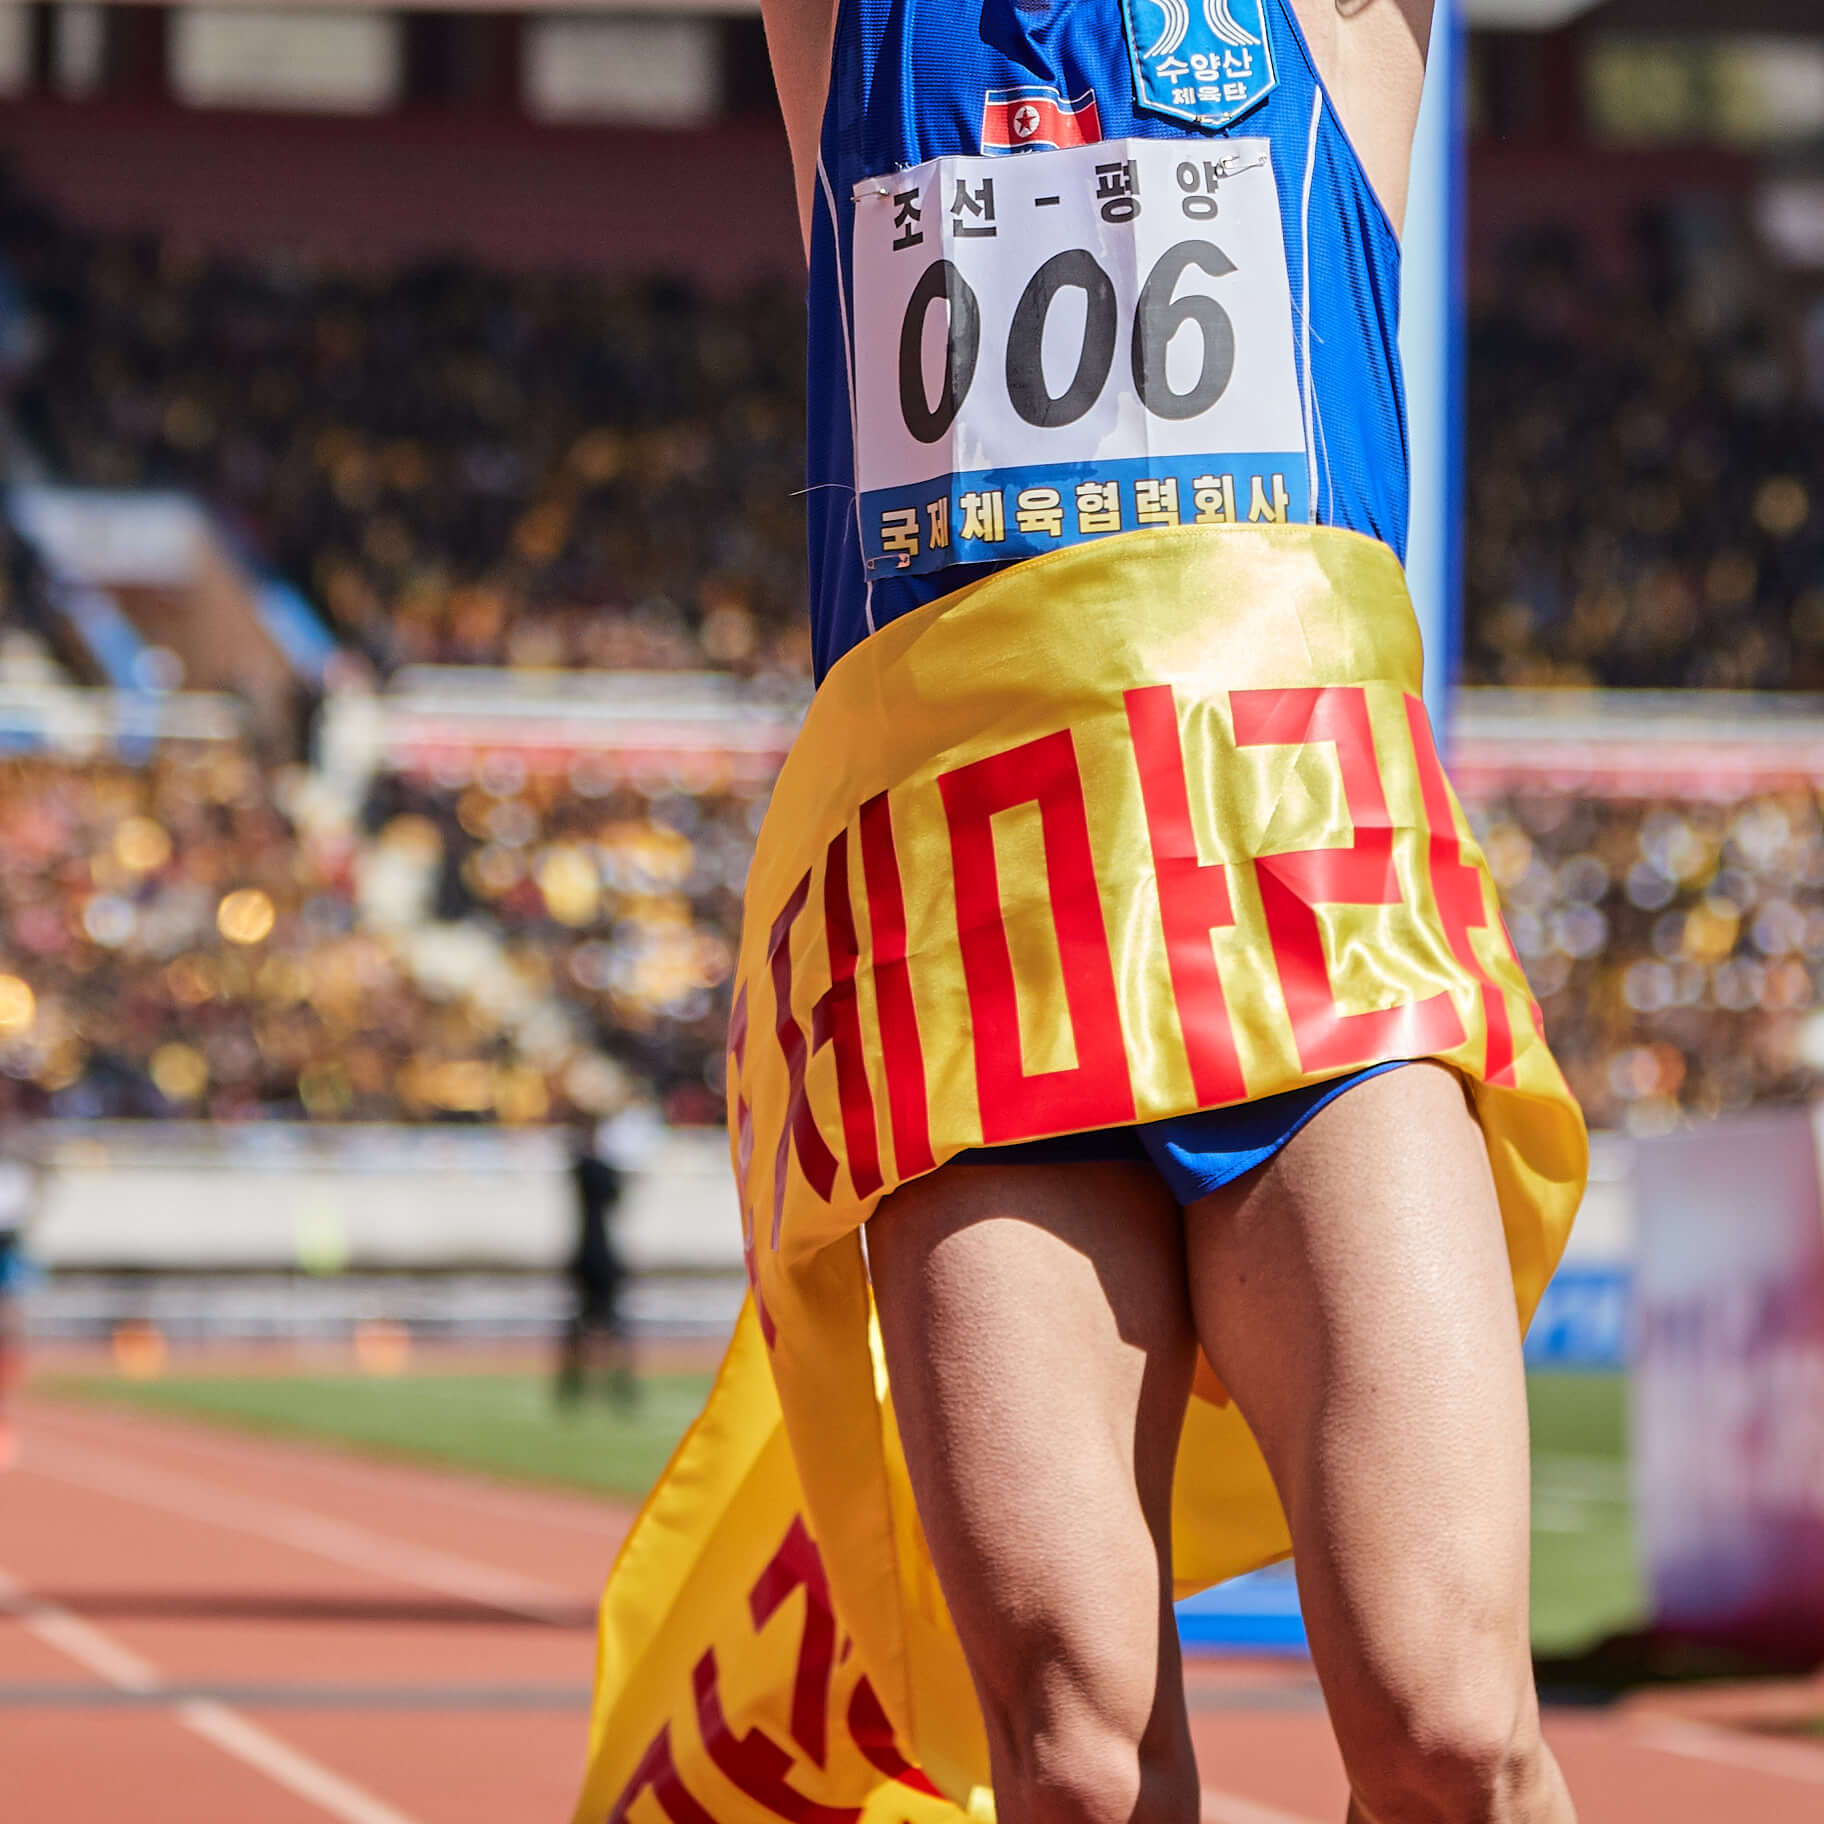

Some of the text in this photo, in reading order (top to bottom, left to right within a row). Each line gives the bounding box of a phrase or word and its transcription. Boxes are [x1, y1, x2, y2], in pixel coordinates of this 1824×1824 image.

[1155, 47, 1253, 84] 수양산
[1171, 81, 1247, 105] 체육단
[898, 239, 1239, 445] 006
[878, 473, 1289, 559] 국제체육협력회사
